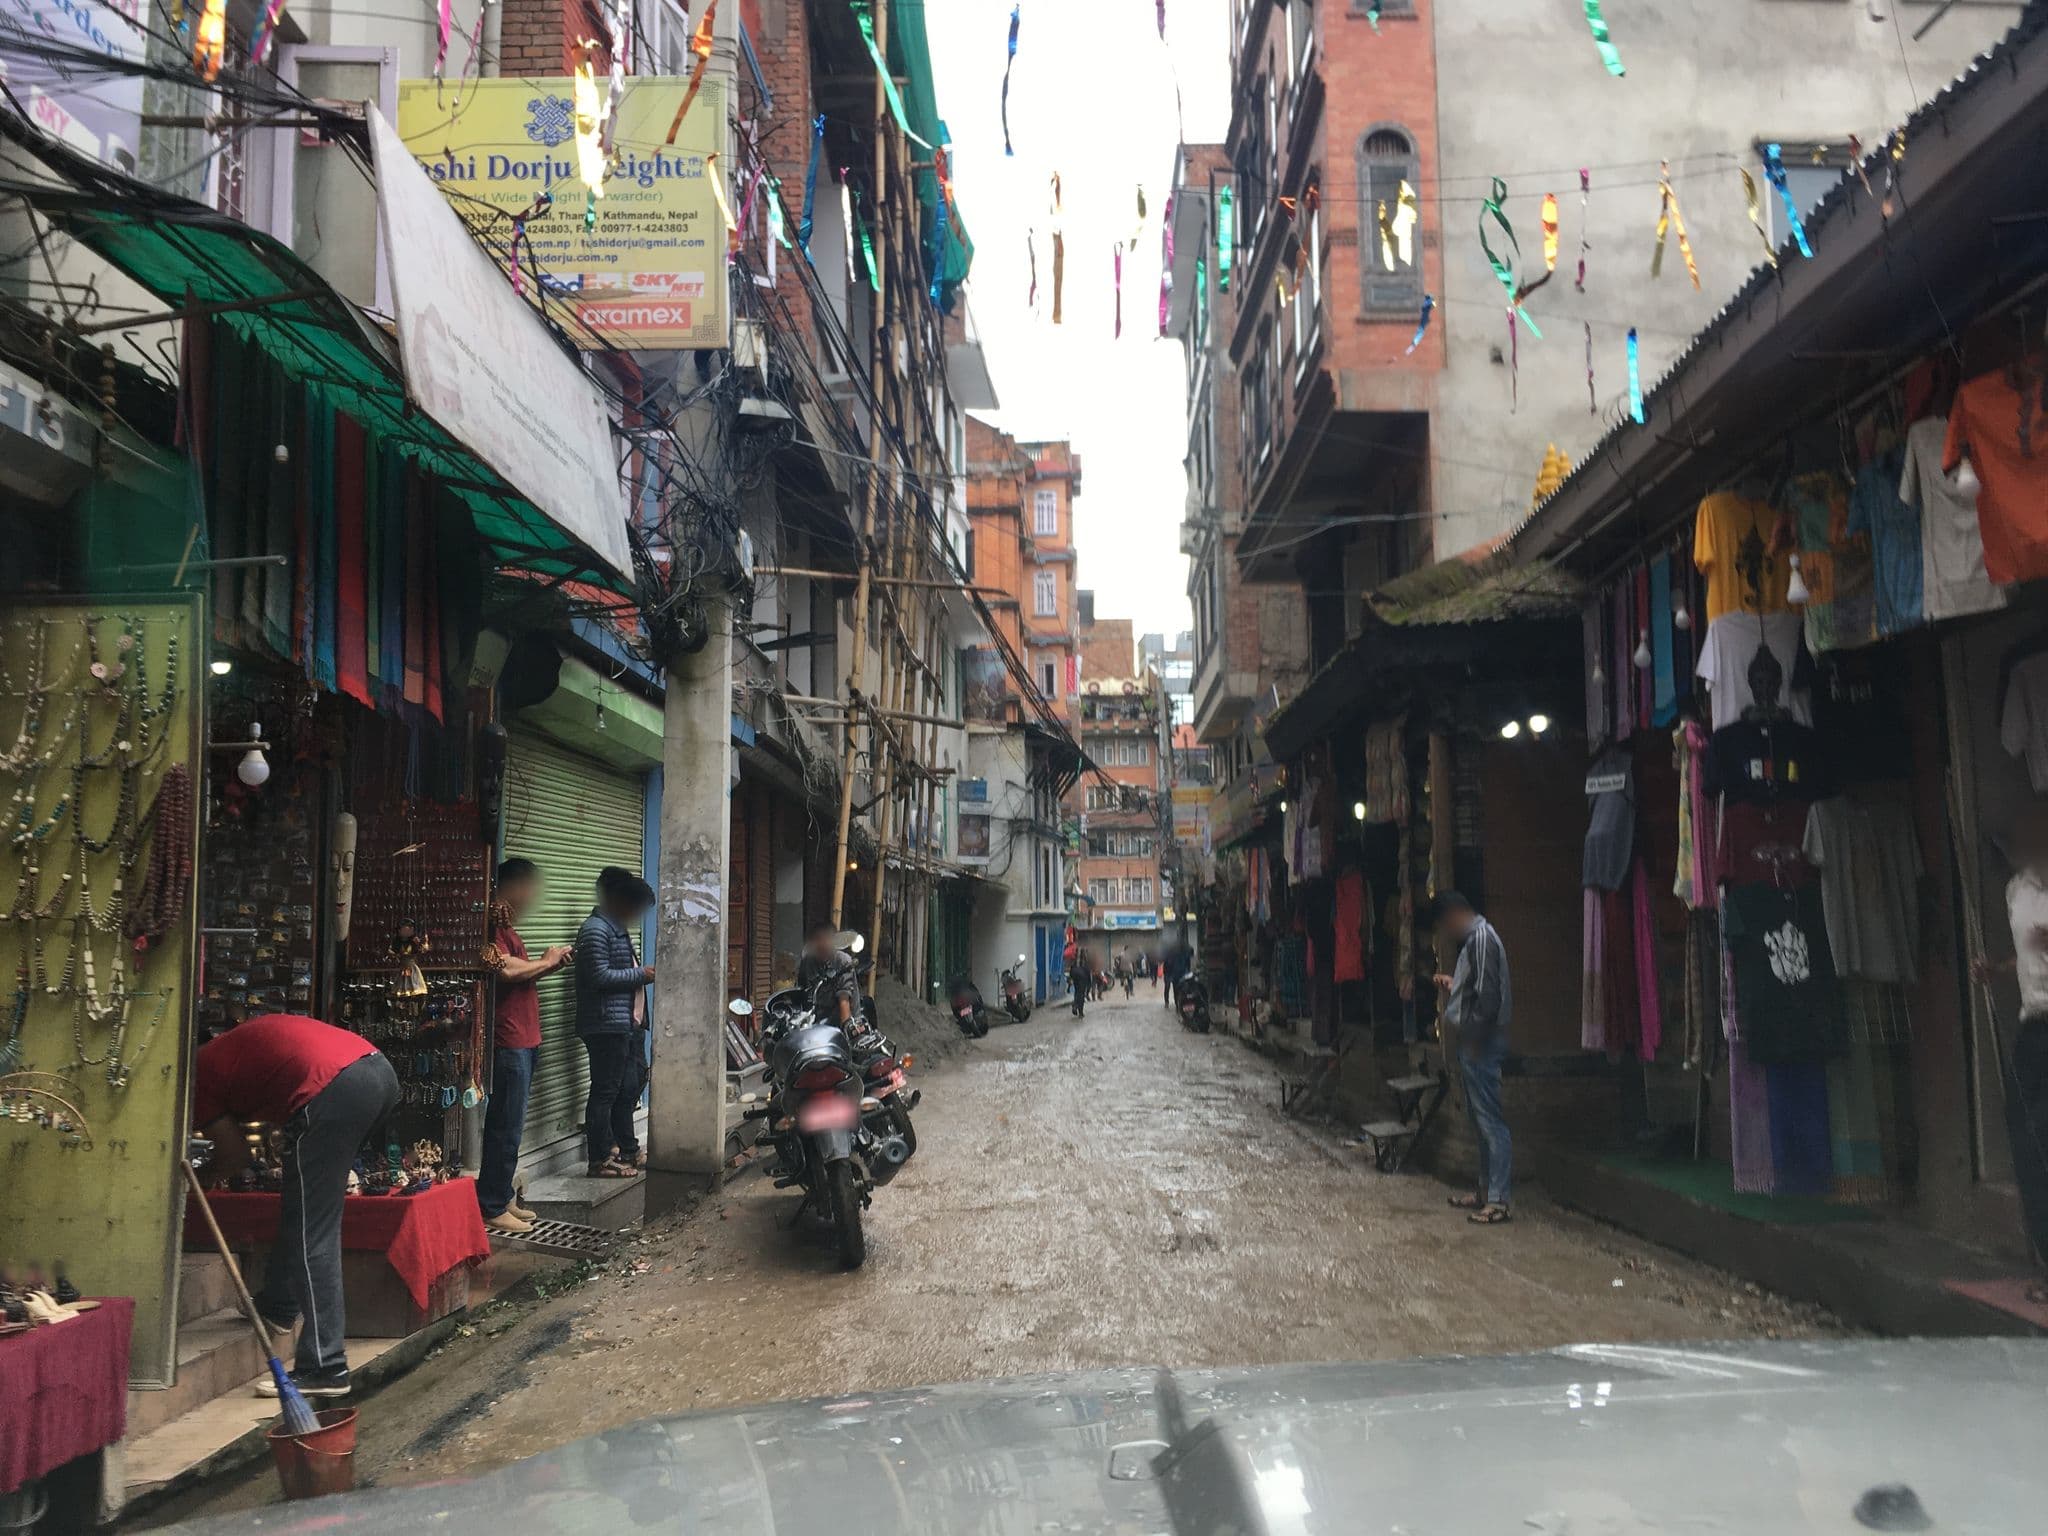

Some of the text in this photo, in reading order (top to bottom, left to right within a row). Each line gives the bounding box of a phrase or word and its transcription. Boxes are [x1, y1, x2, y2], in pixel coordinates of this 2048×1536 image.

[487, 153, 575, 189] Dorju
[491, 191, 528, 203] Wide
[603, 210, 665, 221] Kathmandu,
[668, 210, 698, 222] Nepal
[600, 223, 689, 233] 00977-1-4243803
[633, 273, 679, 287] SKY
[582, 306, 685, 325] aramex
